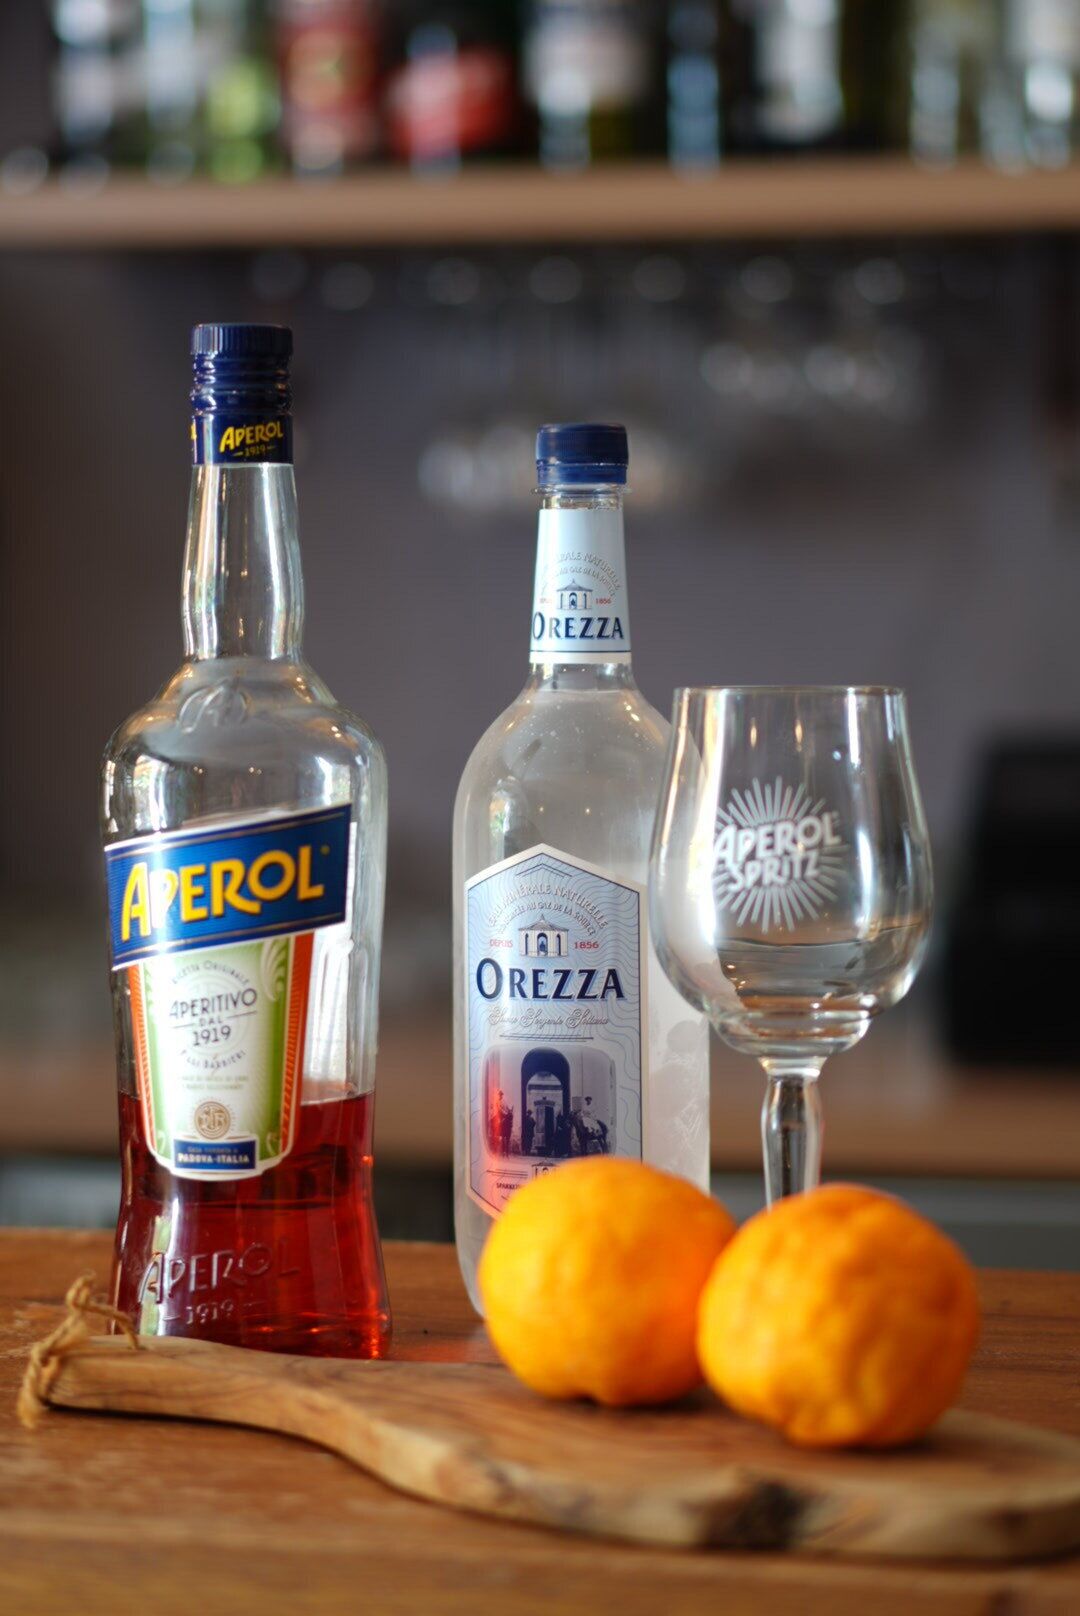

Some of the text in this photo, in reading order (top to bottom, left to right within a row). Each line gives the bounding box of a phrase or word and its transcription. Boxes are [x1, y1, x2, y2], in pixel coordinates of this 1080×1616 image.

[219, 421, 284, 453] APEROL
[532, 611, 624, 640] OREZZA
[713, 811, 842, 868] APEROL
[727, 849, 820, 893] SPRITZ
[121, 845, 325, 942] APEROL
[555, 885, 609, 929] NATURELLE
[574, 941, 600, 949] 1856
[475, 957, 626, 1000] OREZZA
[169, 988, 257, 1019] APERITIVO
[193, 1025, 231, 1047] 1919
